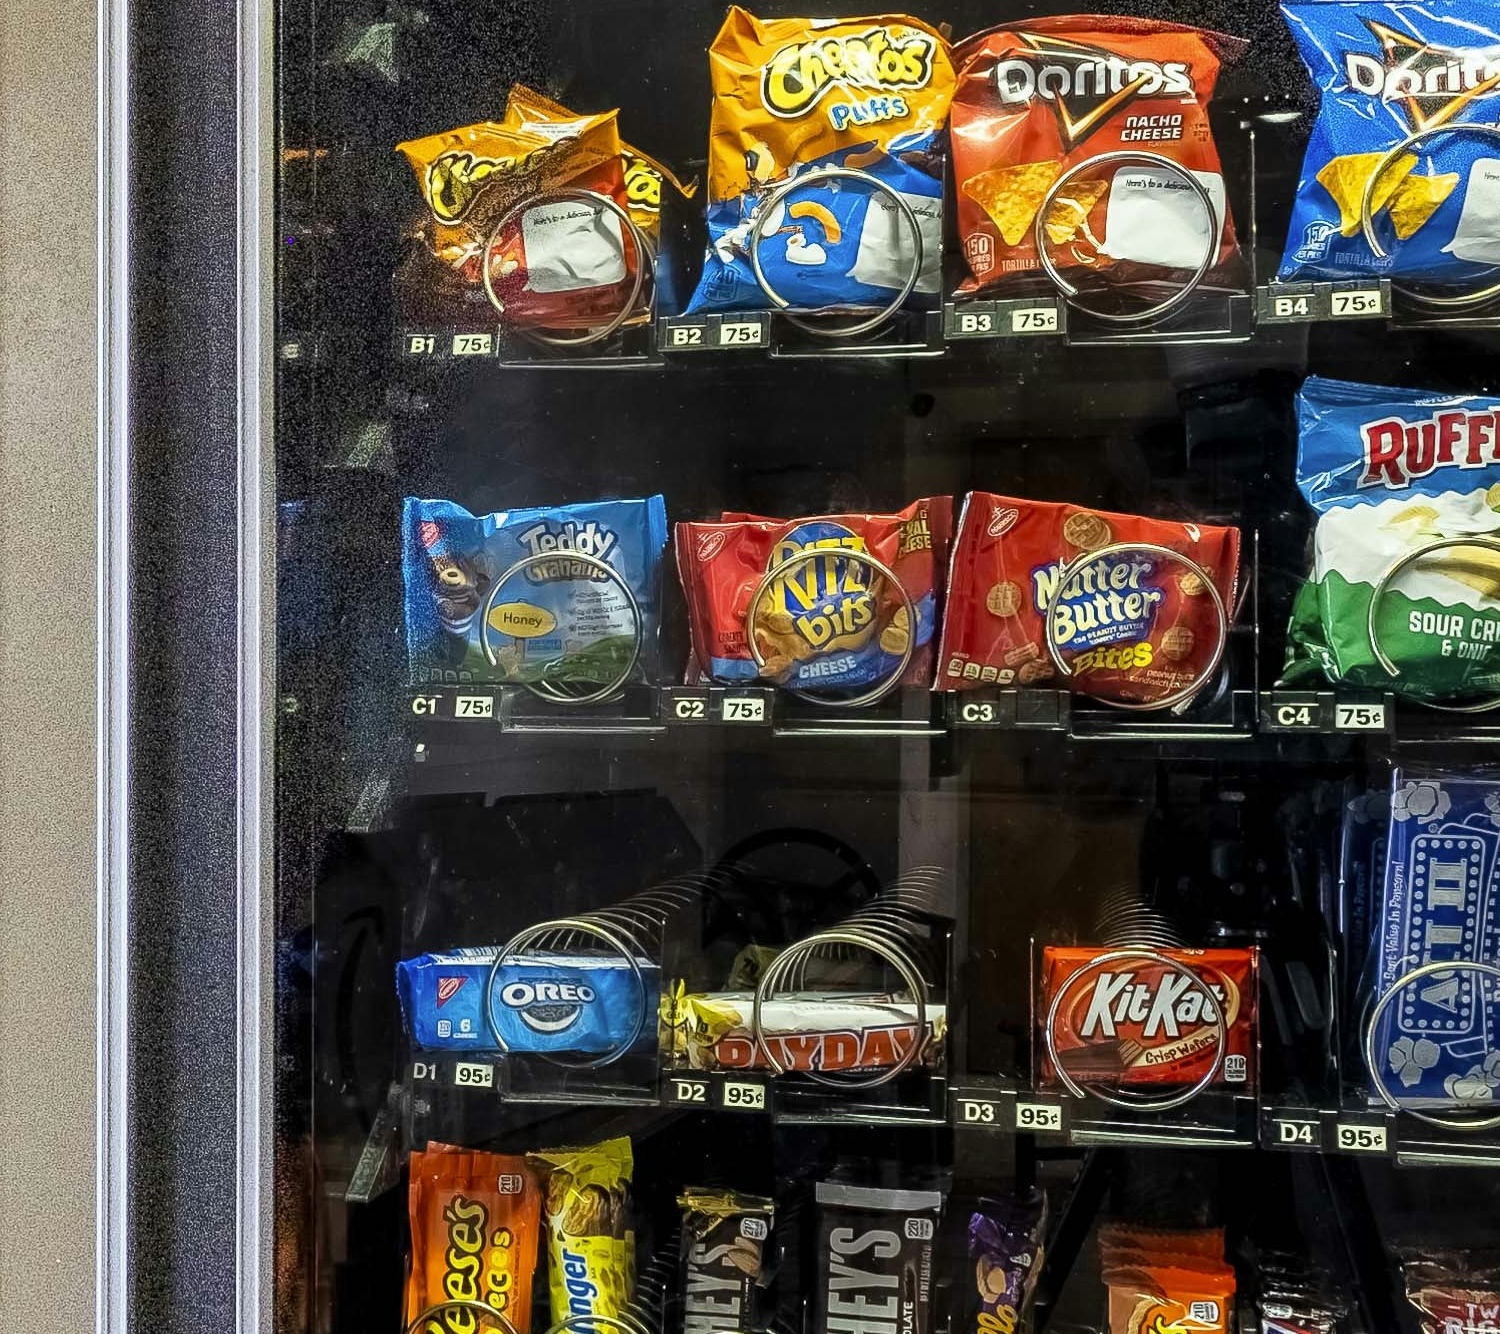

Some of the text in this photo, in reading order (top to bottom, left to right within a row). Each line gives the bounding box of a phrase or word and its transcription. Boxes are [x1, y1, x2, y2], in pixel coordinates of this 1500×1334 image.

[767, 30, 928, 109] Cheetos
[997, 58, 1193, 104] Doritos
[1126, 114, 1182, 128] NACHO
[1120, 128, 1182, 142] CHEESE
[1275, 299, 1309, 316] B4
[961, 314, 991, 332] B3
[411, 338, 435, 354] B1
[673, 329, 701, 345] B2
[520, 522, 615, 559] Teddy
[769, 537, 867, 611] RITZ
[1033, 560, 1152, 610] Nutter
[503, 612, 543, 628] Honey
[797, 596, 874, 647] bits
[1053, 590, 1161, 644] Butter
[1409, 610, 1462, 637] SOUR
[1441, 642, 1452, 657] &
[799, 655, 857, 679] CHEESE
[1073, 642, 1153, 678] Bites
[412, 698, 436, 715] C1
[676, 701, 704, 718] C2
[963, 704, 993, 721] C3
[1277, 706, 1311, 726] C4
[502, 983, 596, 1007] OREO
[1145, 1046, 1177, 1063] Crisp
[413, 1063, 436, 1080] D1
[678, 1083, 705, 1101] D2
[964, 1103, 994, 1122] D3
[1280, 1124, 1313, 1143] D4
